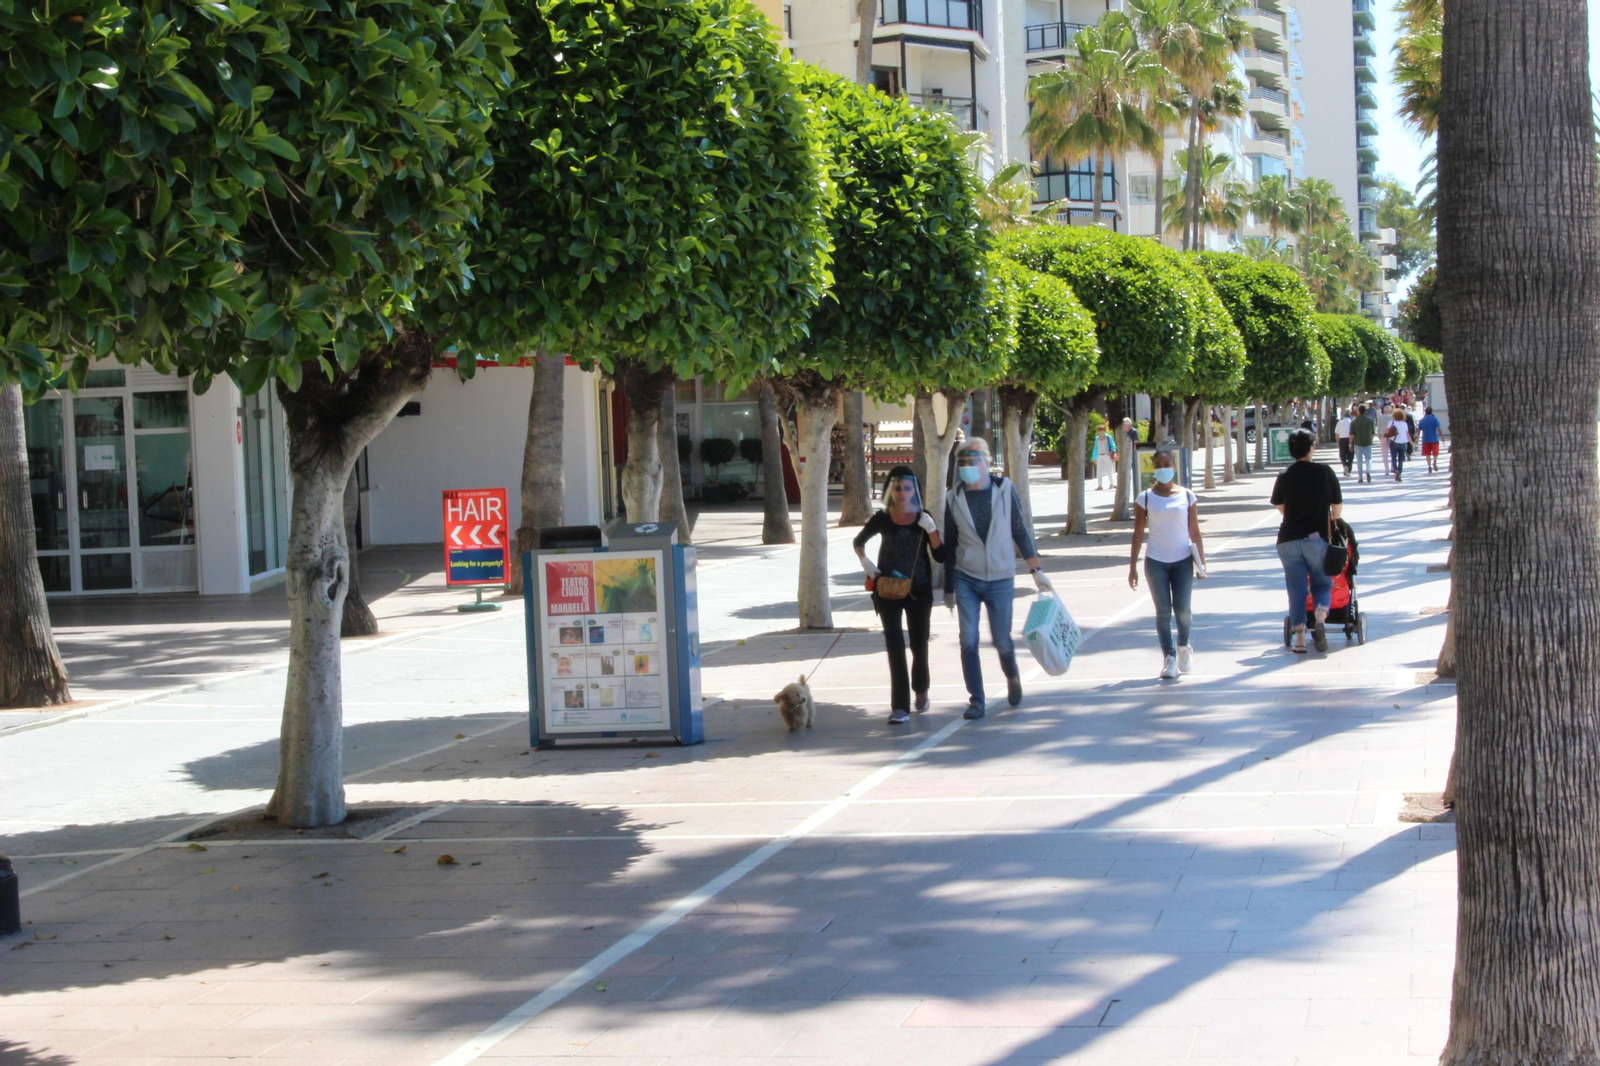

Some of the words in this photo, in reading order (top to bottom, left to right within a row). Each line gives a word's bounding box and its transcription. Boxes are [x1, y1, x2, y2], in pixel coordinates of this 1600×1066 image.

[447, 497, 503, 522] HAIR
[450, 560, 469, 568] Looking
[481, 560, 504, 568] property?
[567, 563, 588, 572] 2020
[560, 577, 588, 588] TEATRO
[561, 587, 589, 597] CIUDAD
[551, 602, 590, 614] MARBELLA
